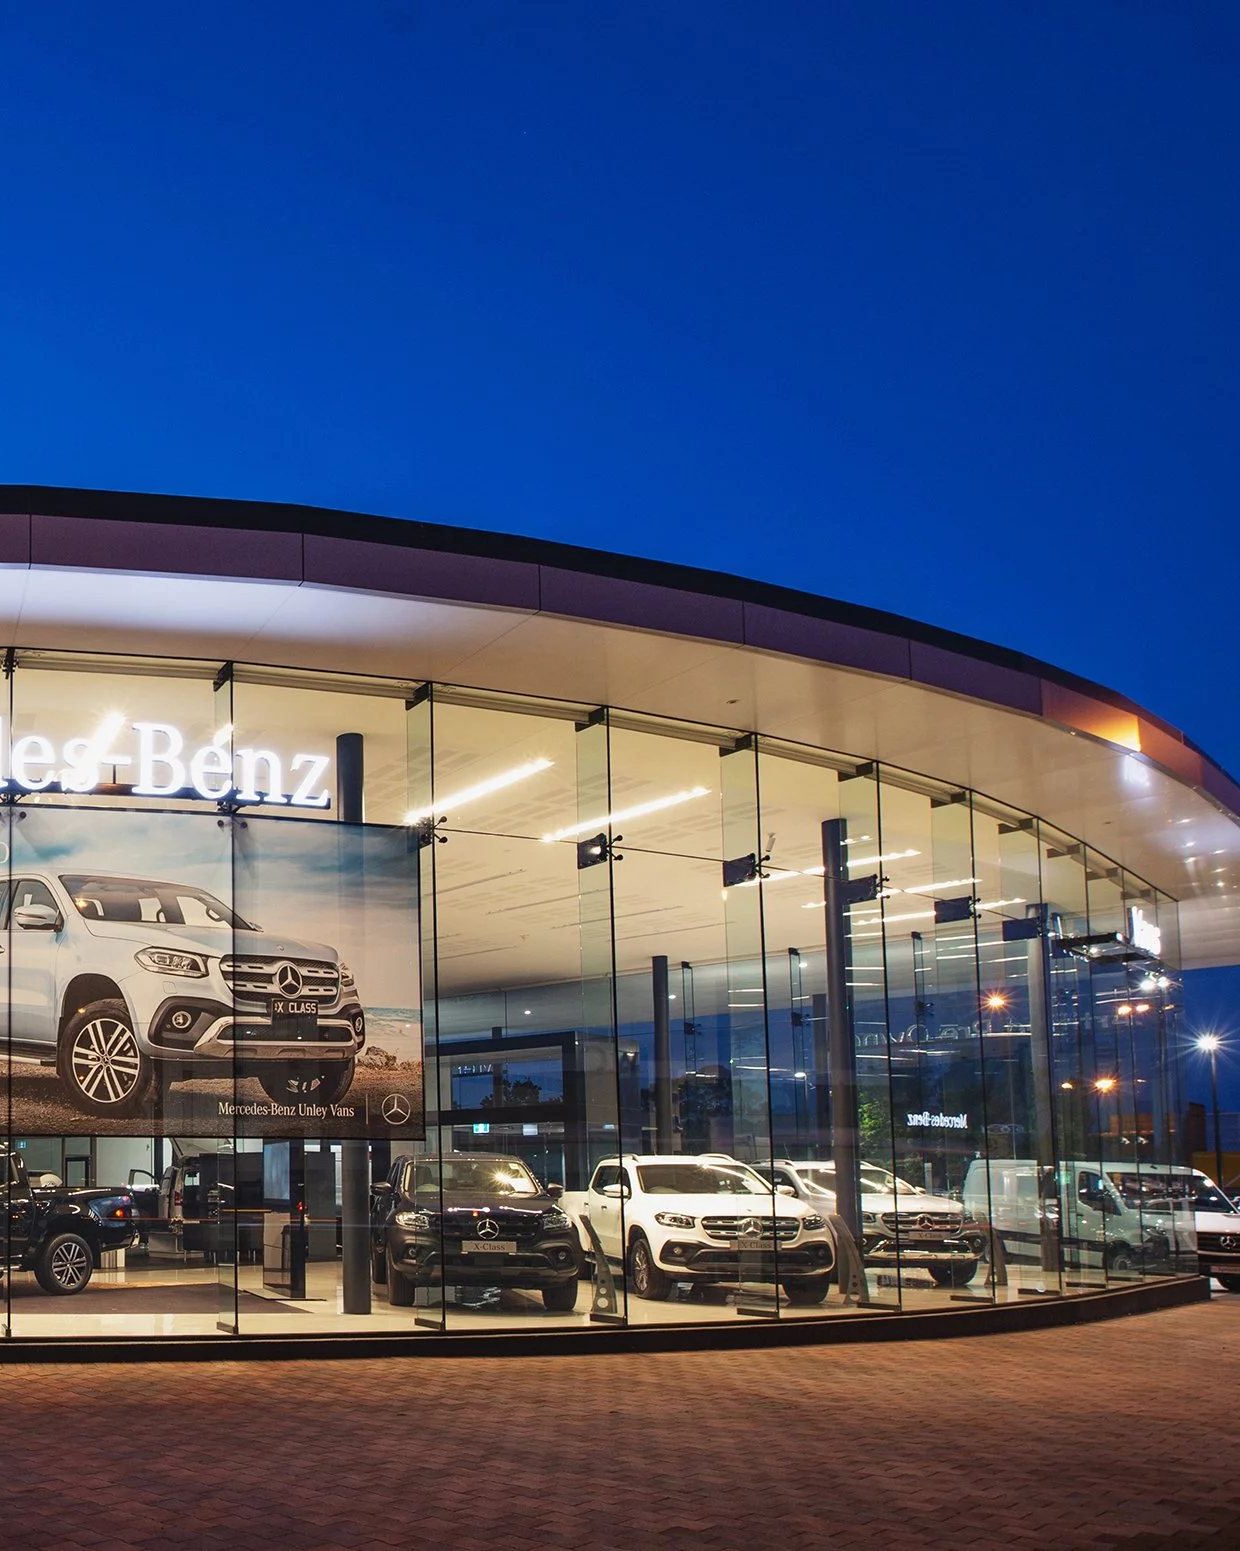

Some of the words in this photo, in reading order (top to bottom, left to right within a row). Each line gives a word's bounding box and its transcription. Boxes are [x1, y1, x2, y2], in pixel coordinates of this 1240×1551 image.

[288, 1002, 317, 1014] CLASS
[218, 1101, 296, 1117] Mercedes-Benz
[299, 1103, 328, 1119] Unley
[330, 1104, 355, 1117] Vans
[473, 1242, 506, 1251] X-Class
